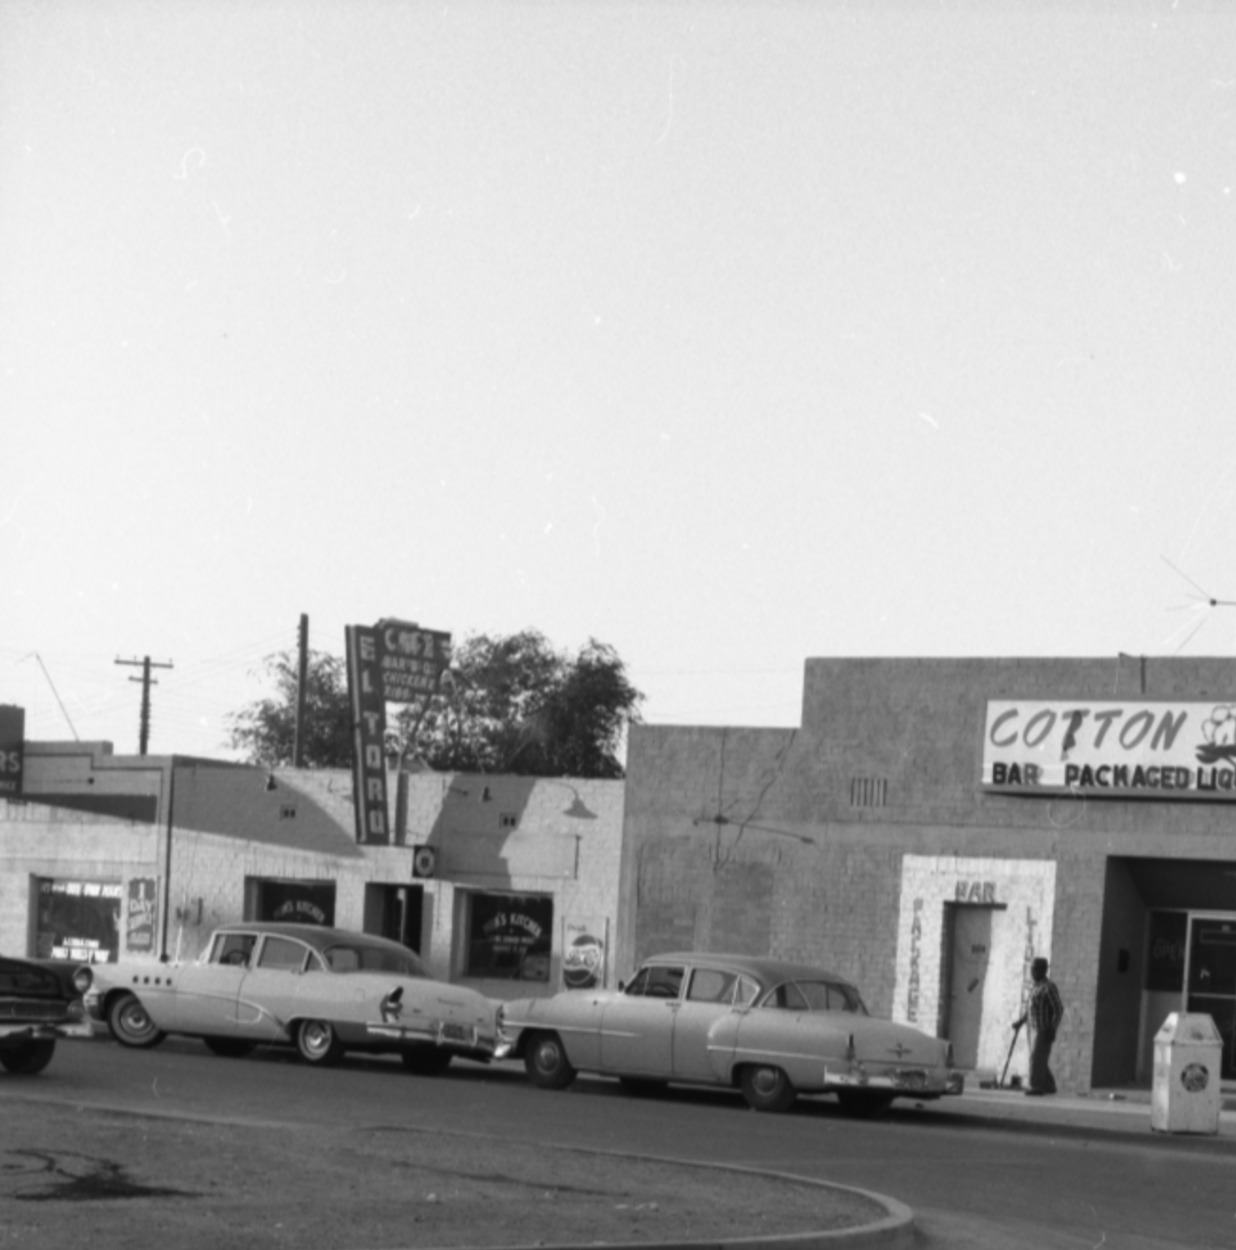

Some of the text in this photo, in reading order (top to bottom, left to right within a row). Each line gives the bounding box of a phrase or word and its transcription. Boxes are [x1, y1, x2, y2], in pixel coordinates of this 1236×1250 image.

[360, 635, 385, 834] EL TORO
[990, 708, 1188, 753] COTTON
[993, 762, 1041, 785] BAR
[1065, 763, 1191, 790] PACKAGED
[955, 880, 996, 903] BAR
